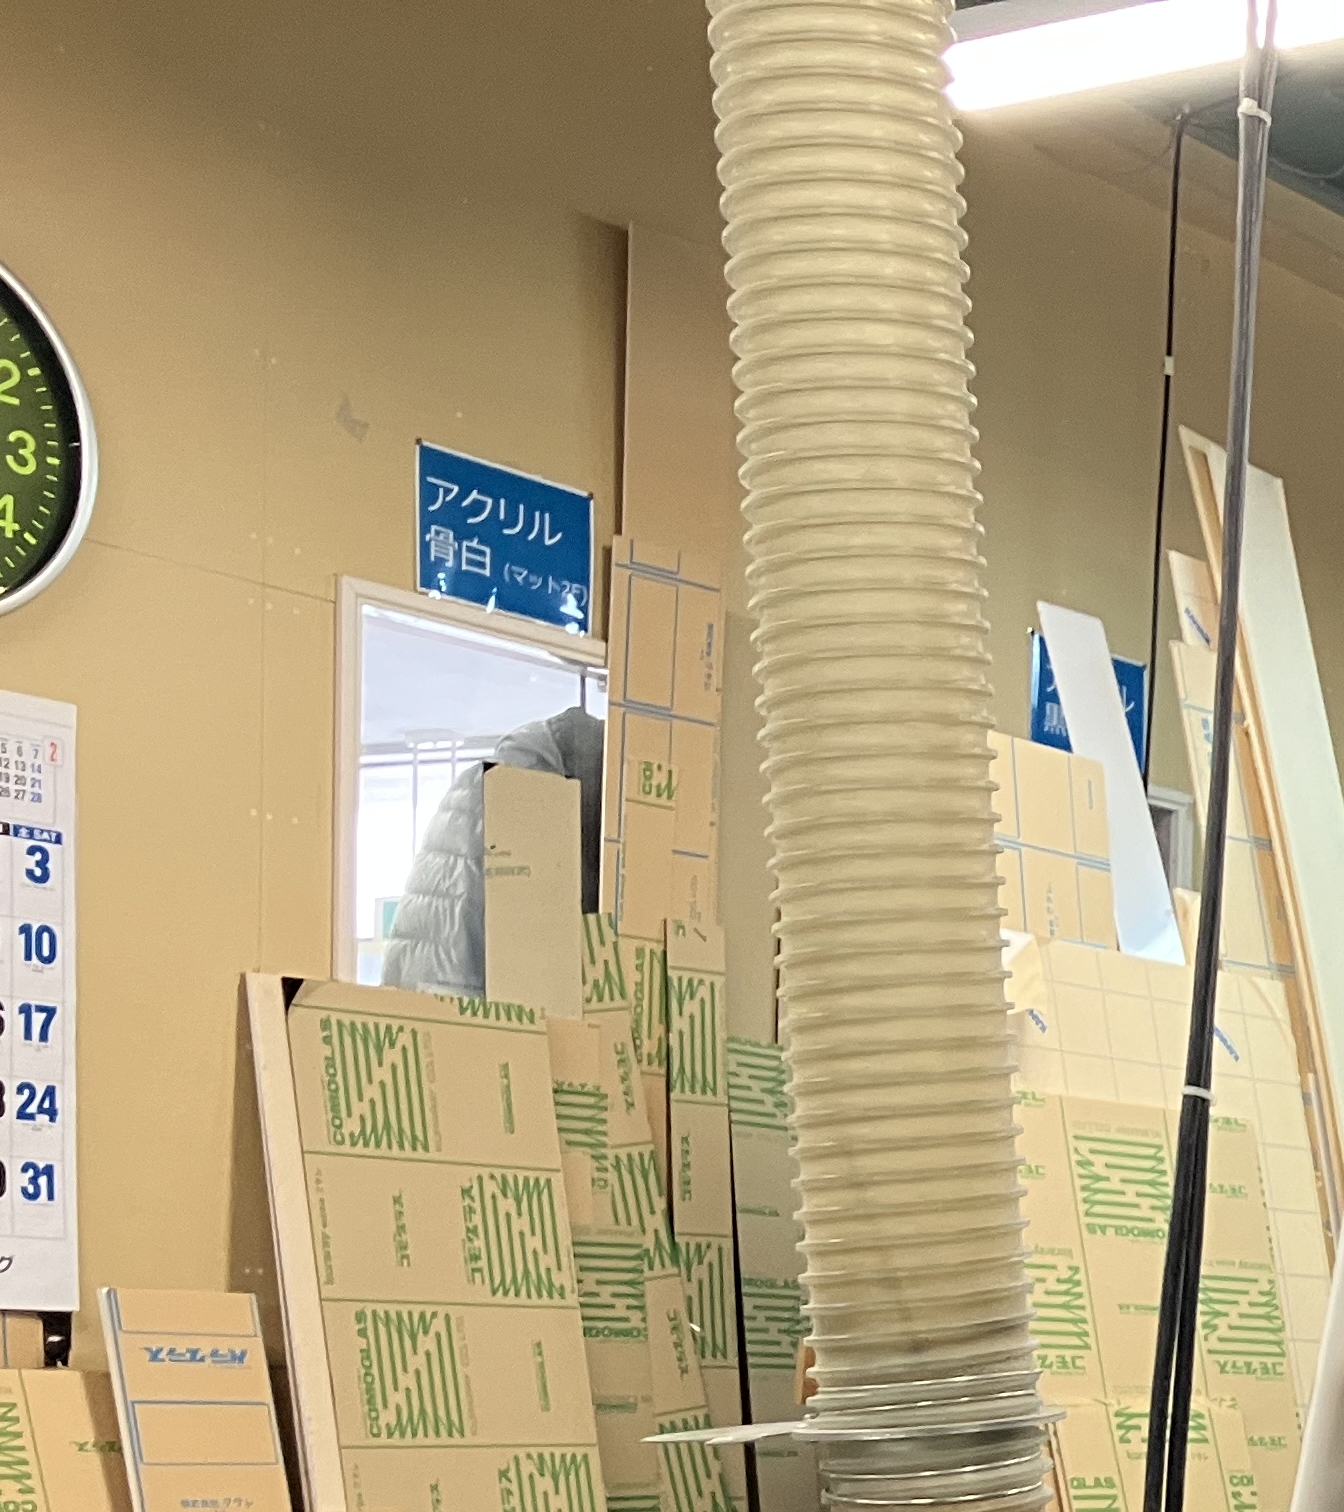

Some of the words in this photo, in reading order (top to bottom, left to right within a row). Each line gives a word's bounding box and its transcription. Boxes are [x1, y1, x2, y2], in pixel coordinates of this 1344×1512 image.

[6, 430, 37, 475] 3
[426, 476, 563, 546] アクリル
[425, 524, 491, 578] 骨白
[25, 845, 51, 885] 3
[18, 923, 57, 965] 10
[18, 1002, 57, 1043] 17
[15, 1081, 59, 1122] 24
[20, 1161, 55, 1202] 31
[1086, 1222, 1167, 1241] OMOGLAS
